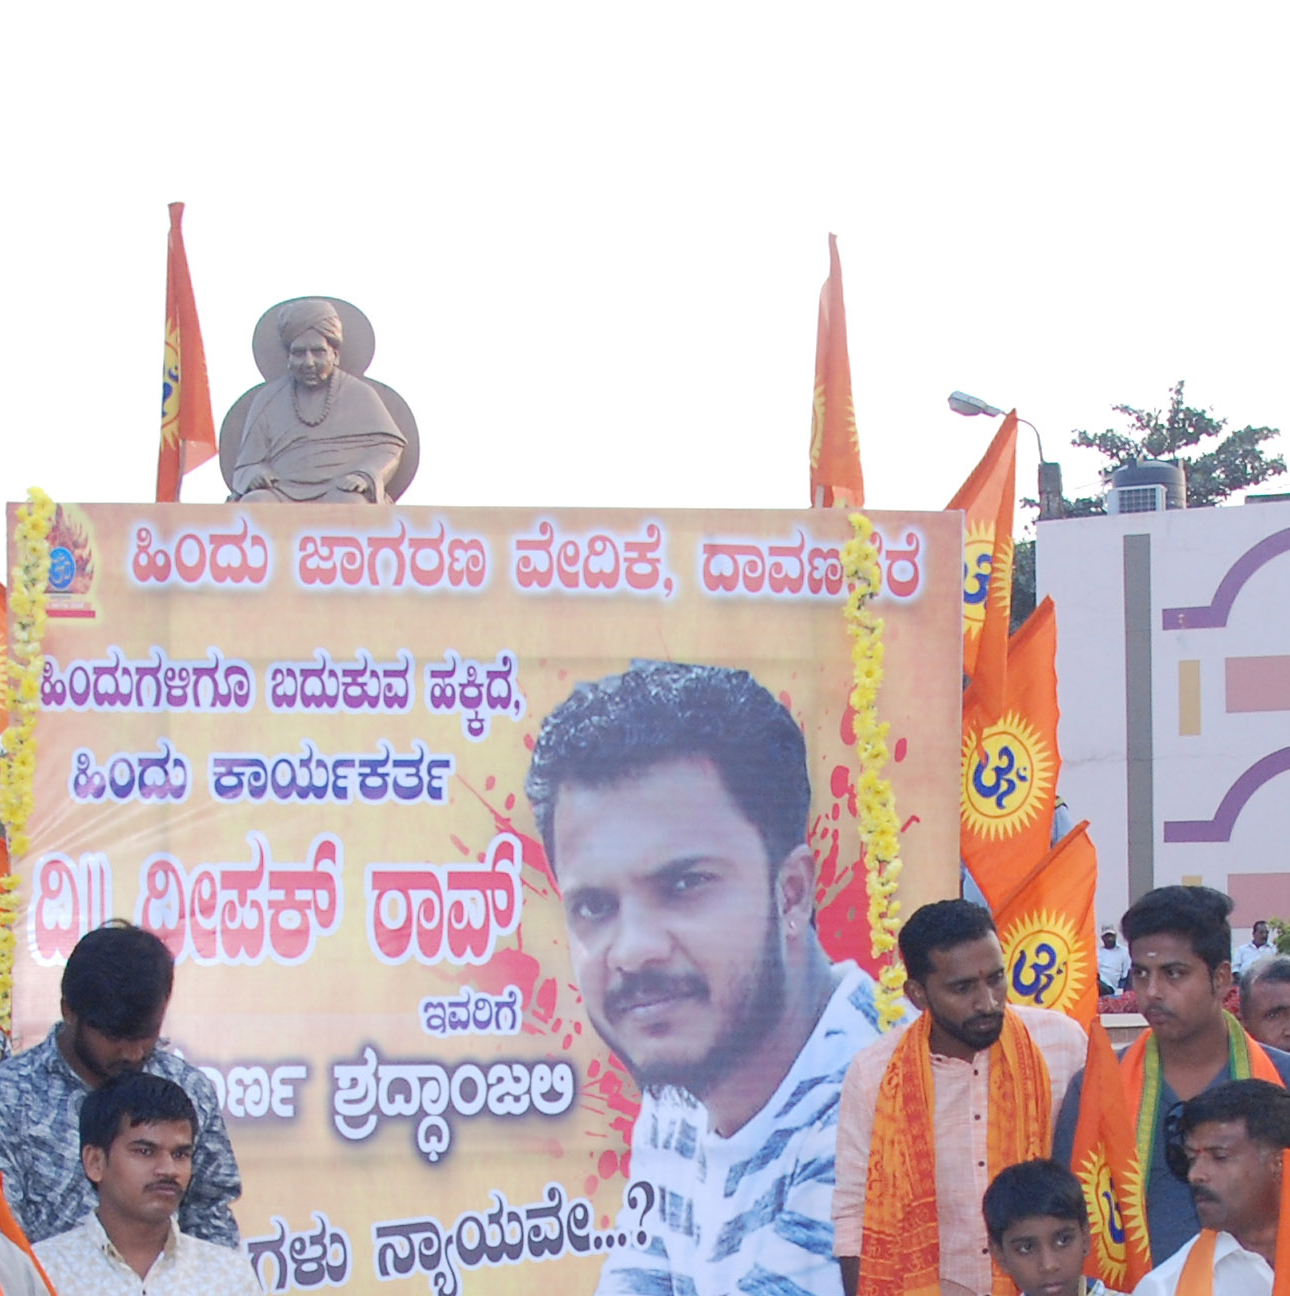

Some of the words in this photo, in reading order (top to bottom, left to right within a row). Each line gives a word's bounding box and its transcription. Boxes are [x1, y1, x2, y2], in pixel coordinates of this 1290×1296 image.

[132, 517, 269, 585] ಹಿಂದು
[299, 518, 486, 588] ಜಾಗರಣ
[516, 521, 673, 599] ವೇದಿಕೆ,
[703, 529, 920, 597] ದಾವಣರೆ
[41, 649, 251, 709] ಹಿಂದುಗಳಿಗೂ
[271, 649, 409, 709] ಬದುಕುವ
[430, 652, 520, 736] ಹಕ್ಕಿದೆ,
[73, 741, 186, 798] ಹಿಂದು
[214, 740, 451, 799] ಕಾರ್ಯಕರ್ತ
[142, 840, 337, 960] ದೀಪಕ್
[372, 841, 514, 959] ರಾವ್
[424, 989, 517, 1033] ಇವರಿಗೆ
[334, 1047, 573, 1162] ಶ್ರದ್ಧಾಂಜಲಿ
